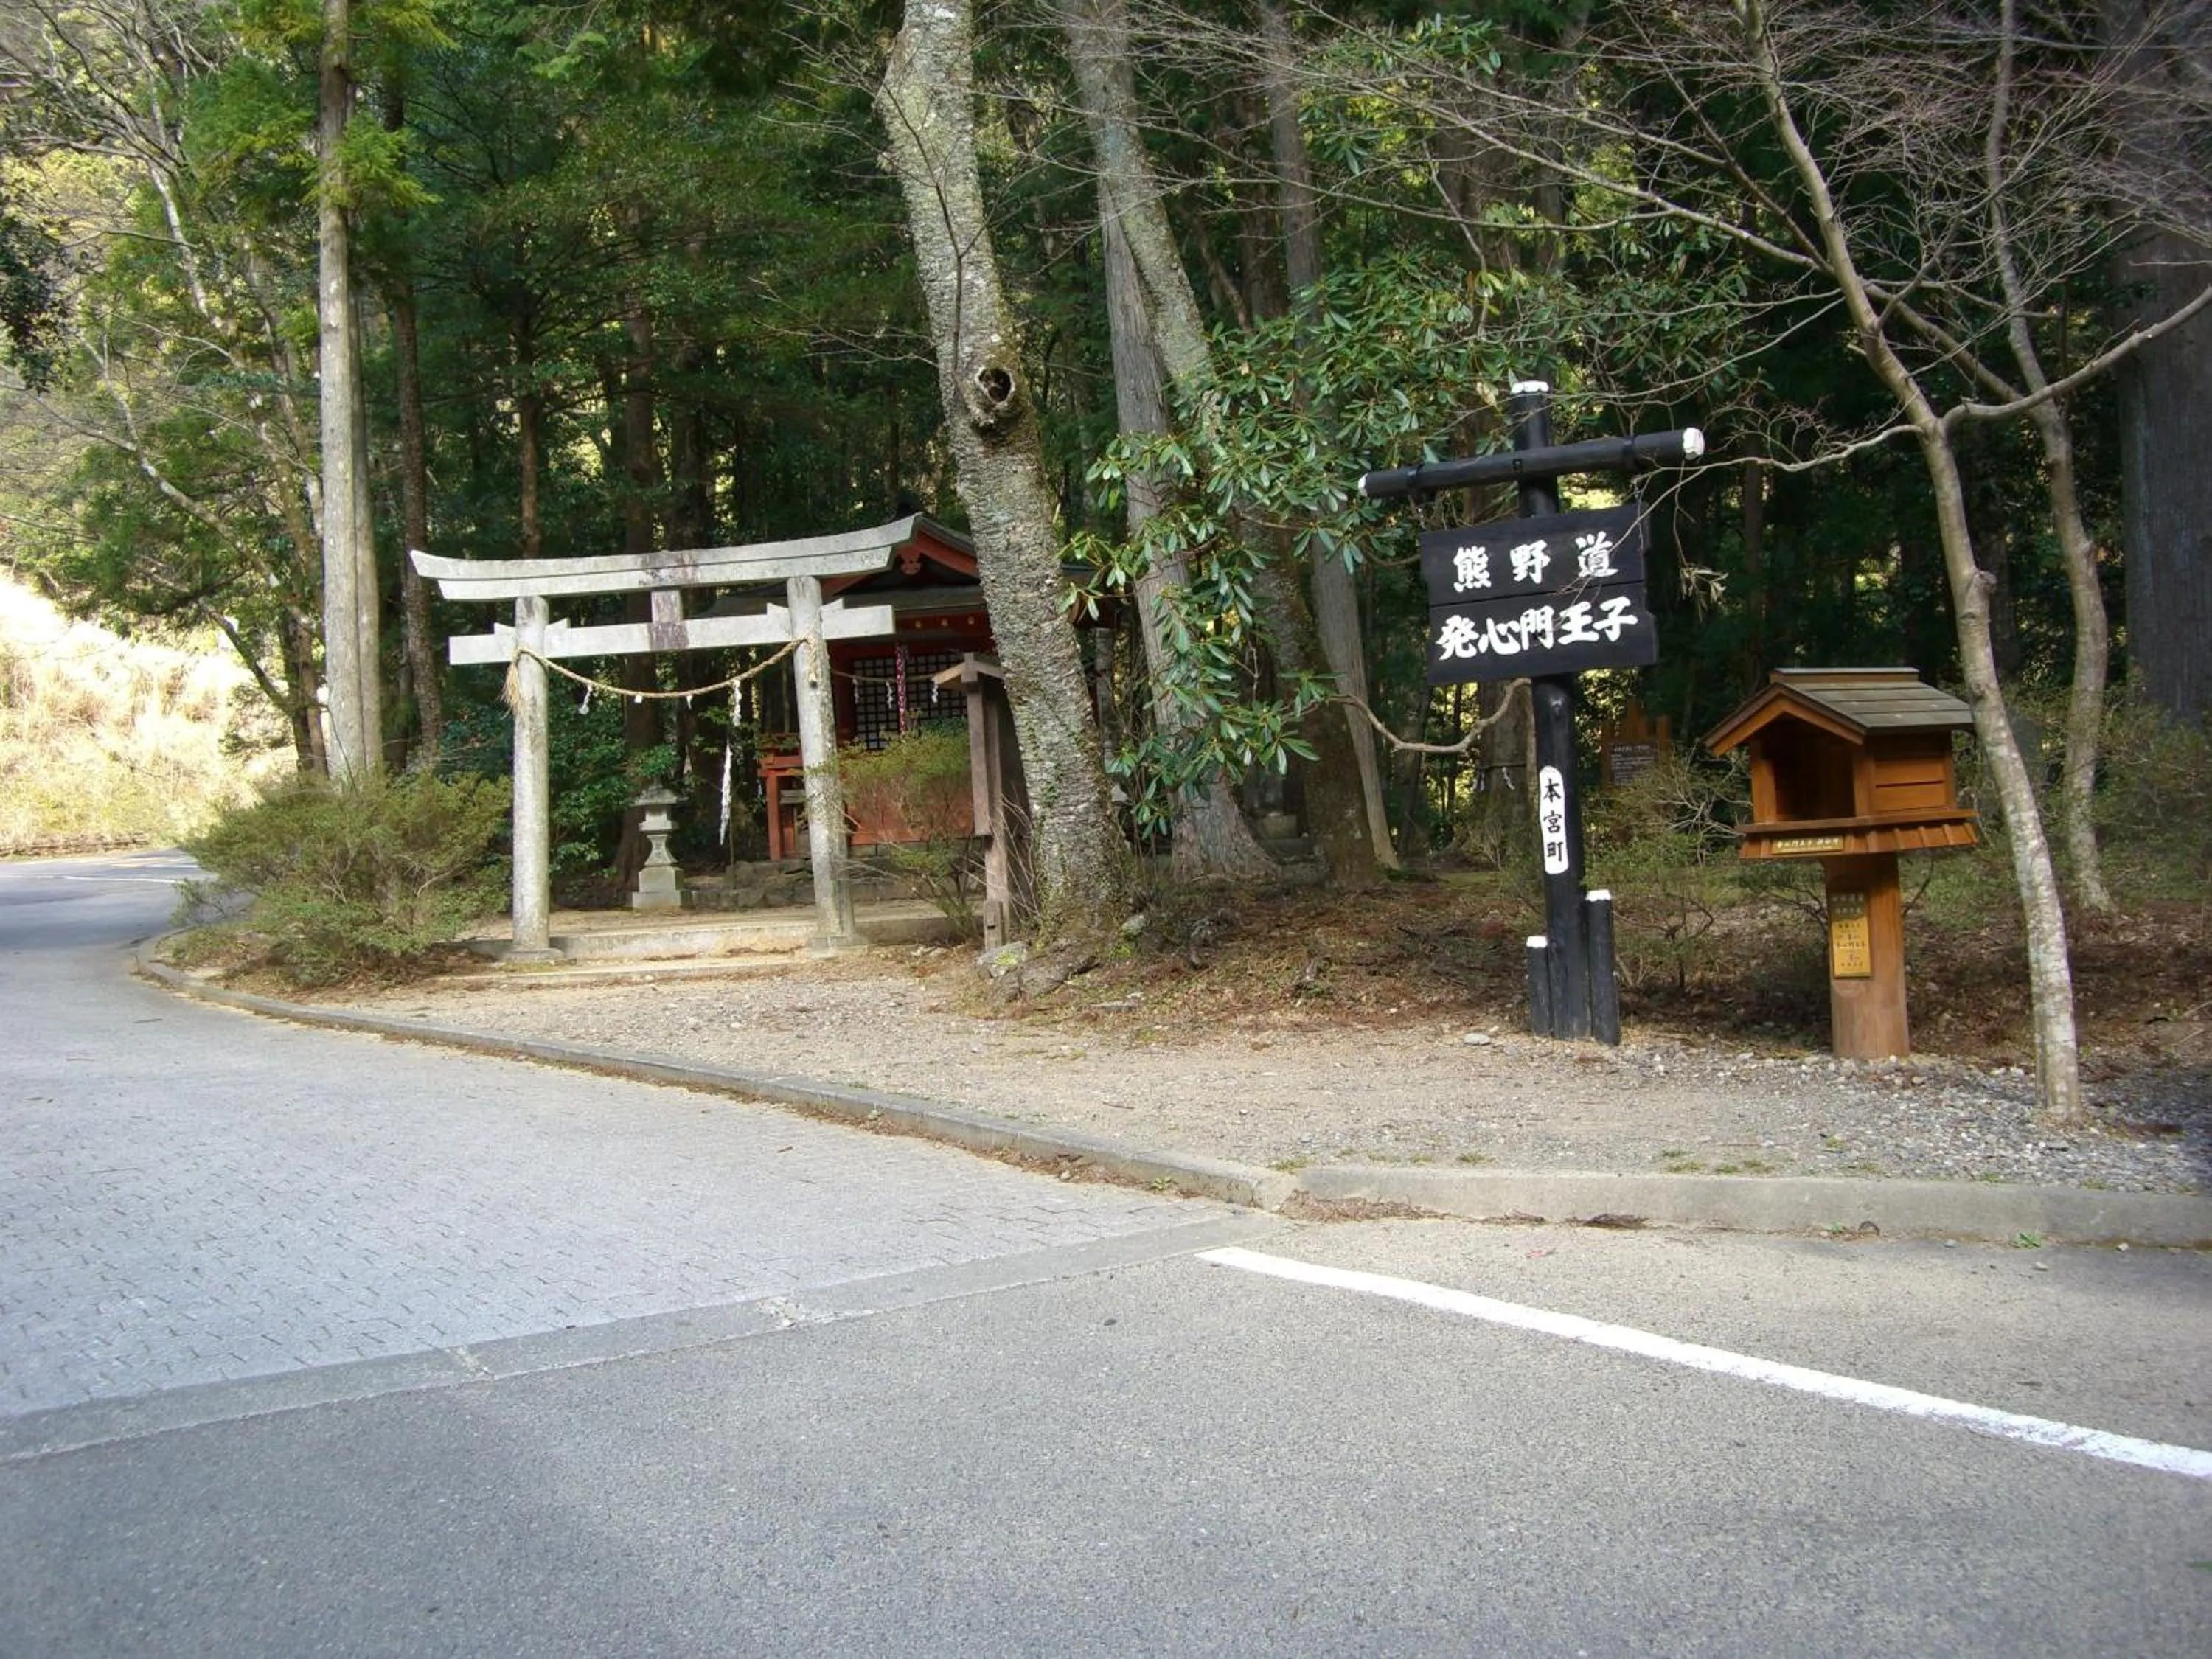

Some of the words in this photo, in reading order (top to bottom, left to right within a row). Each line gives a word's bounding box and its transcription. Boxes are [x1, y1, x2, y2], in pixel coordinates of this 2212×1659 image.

[1453, 530, 1618, 593] 熊野道
[1435, 596, 1638, 661] 発心門王子
[1543, 778, 1564, 862] 本宮町
